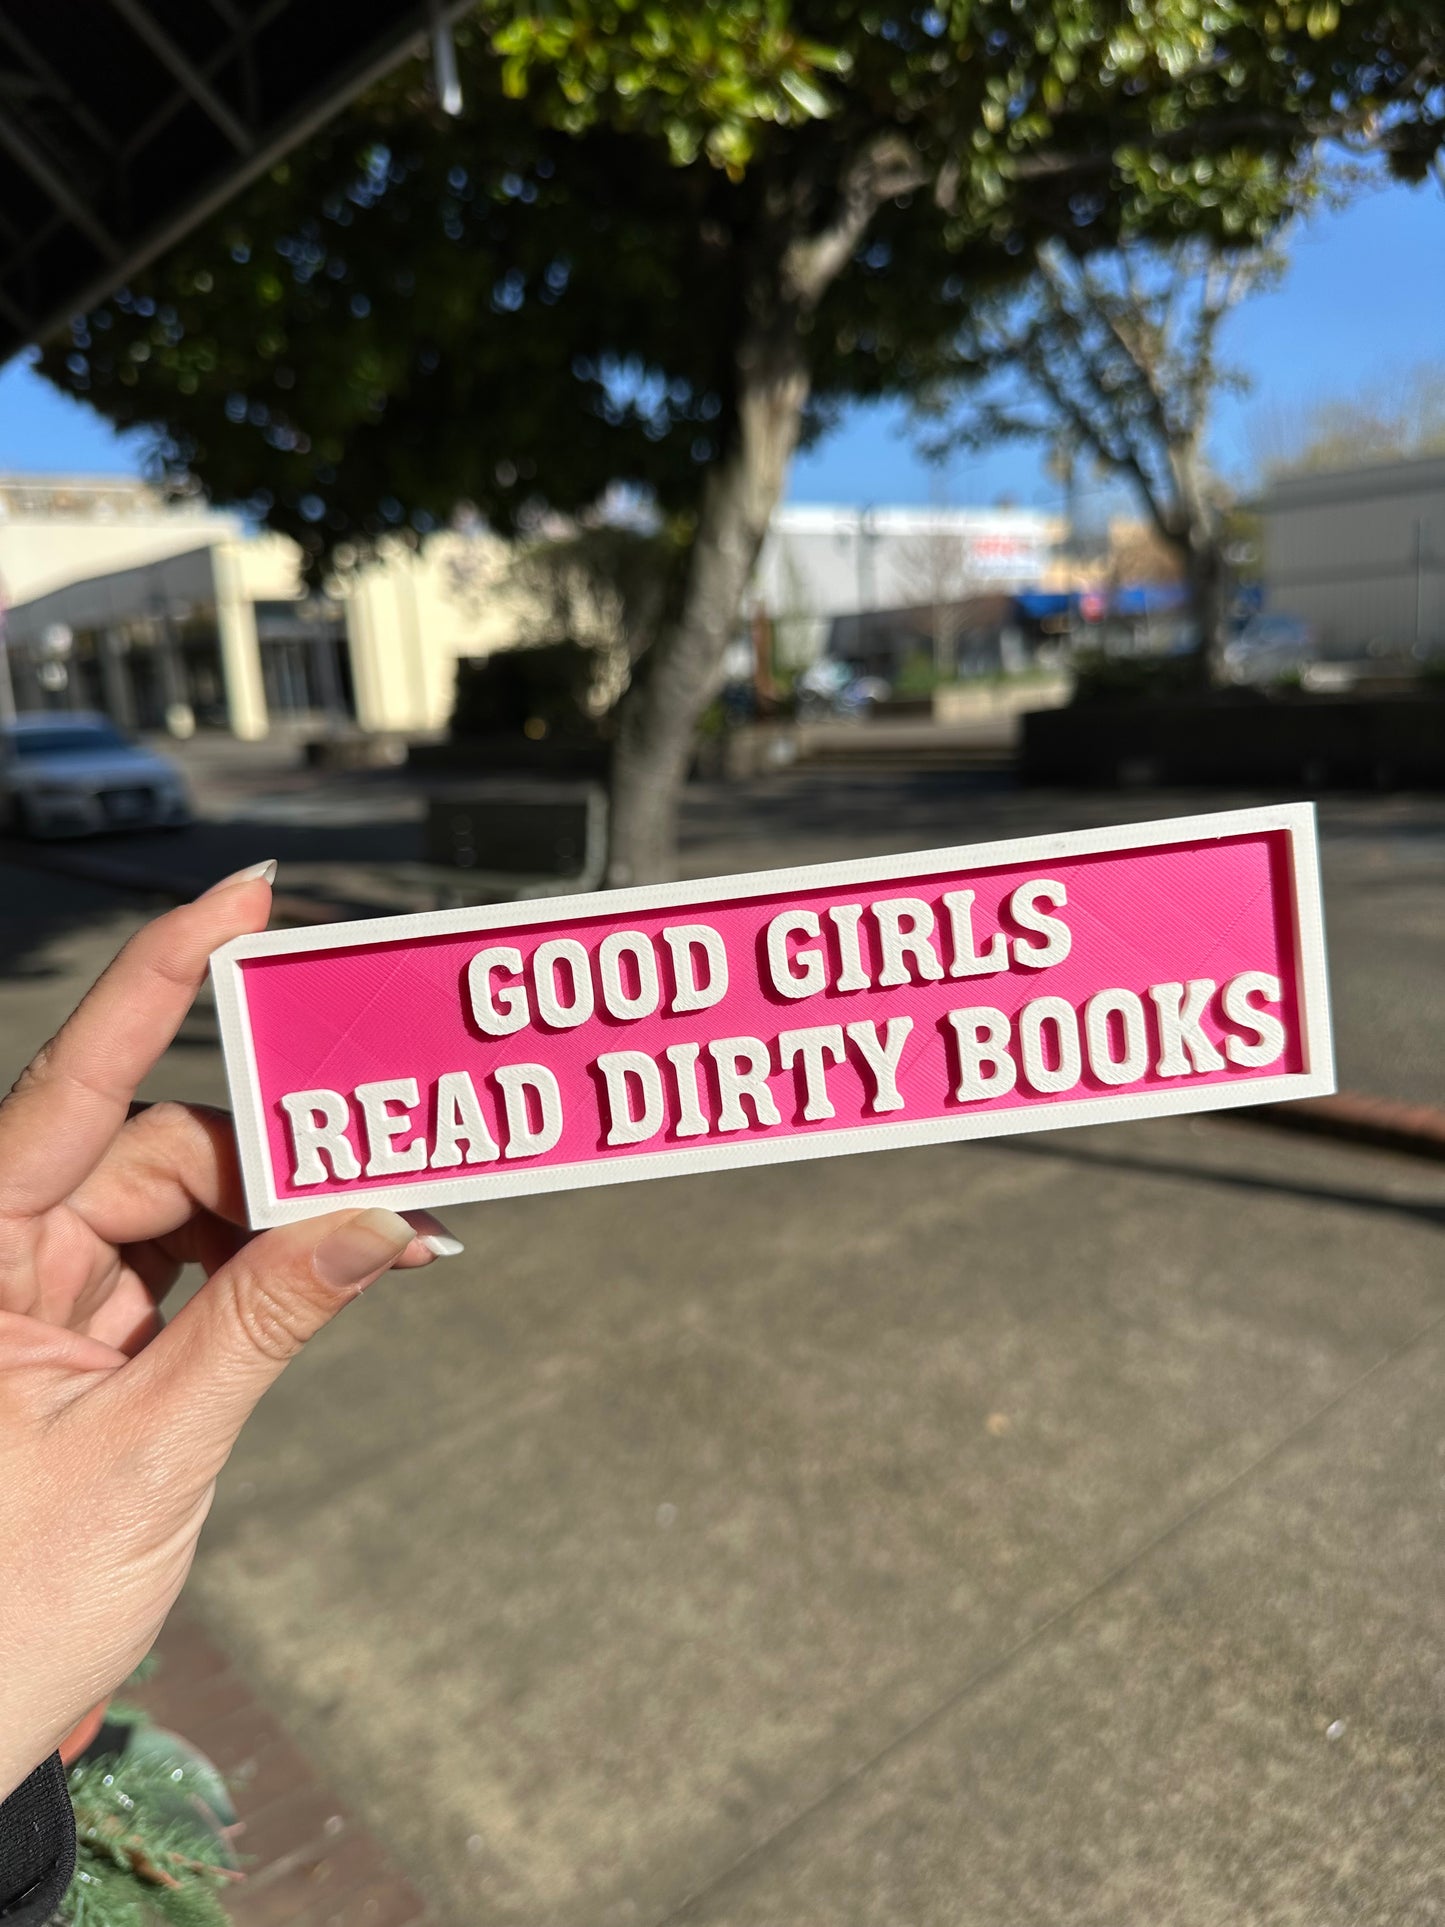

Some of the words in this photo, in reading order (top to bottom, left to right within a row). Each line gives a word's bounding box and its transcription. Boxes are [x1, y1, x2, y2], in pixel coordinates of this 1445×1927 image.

[468, 924, 729, 1036] GOOD
[767, 879, 1072, 999] GIRLS
[281, 1063, 564, 1187] READ
[597, 1016, 914, 1147] DIRTY
[947, 971, 1286, 1103] BOOKS
